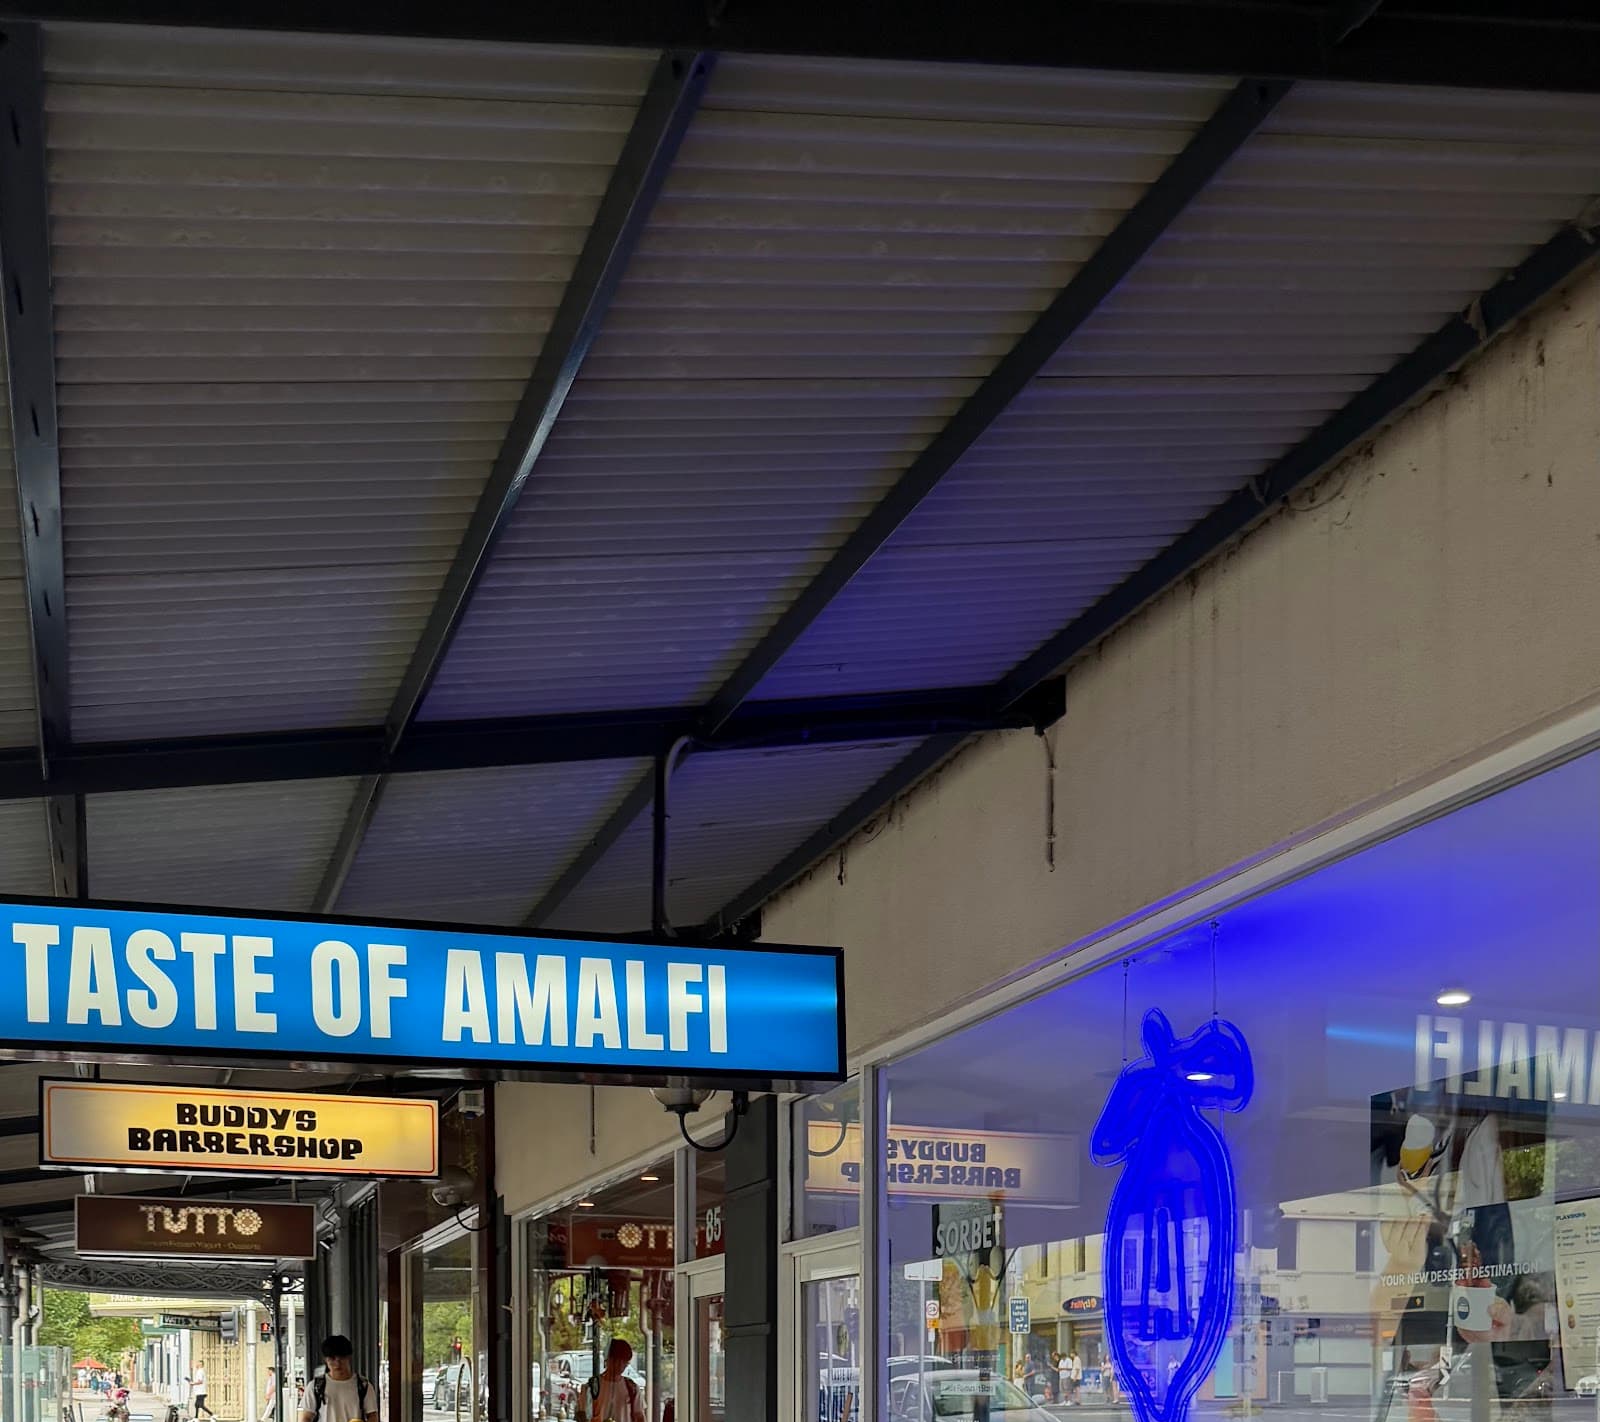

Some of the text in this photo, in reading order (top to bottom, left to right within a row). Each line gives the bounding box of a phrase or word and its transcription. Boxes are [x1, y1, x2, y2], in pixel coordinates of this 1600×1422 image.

[12, 922, 728, 1054] TASTE OF AMALFI
[176, 1103, 317, 1131] BUDDY'S
[128, 1127, 363, 1160] BARBERSHOP
[138, 1204, 263, 1236] TUTTO
[706, 1207, 721, 1242] 85
[936, 1213, 1002, 1256] SORBET
[1380, 1262, 1538, 1287] YOUR NEW DESSERT DESTINATION
